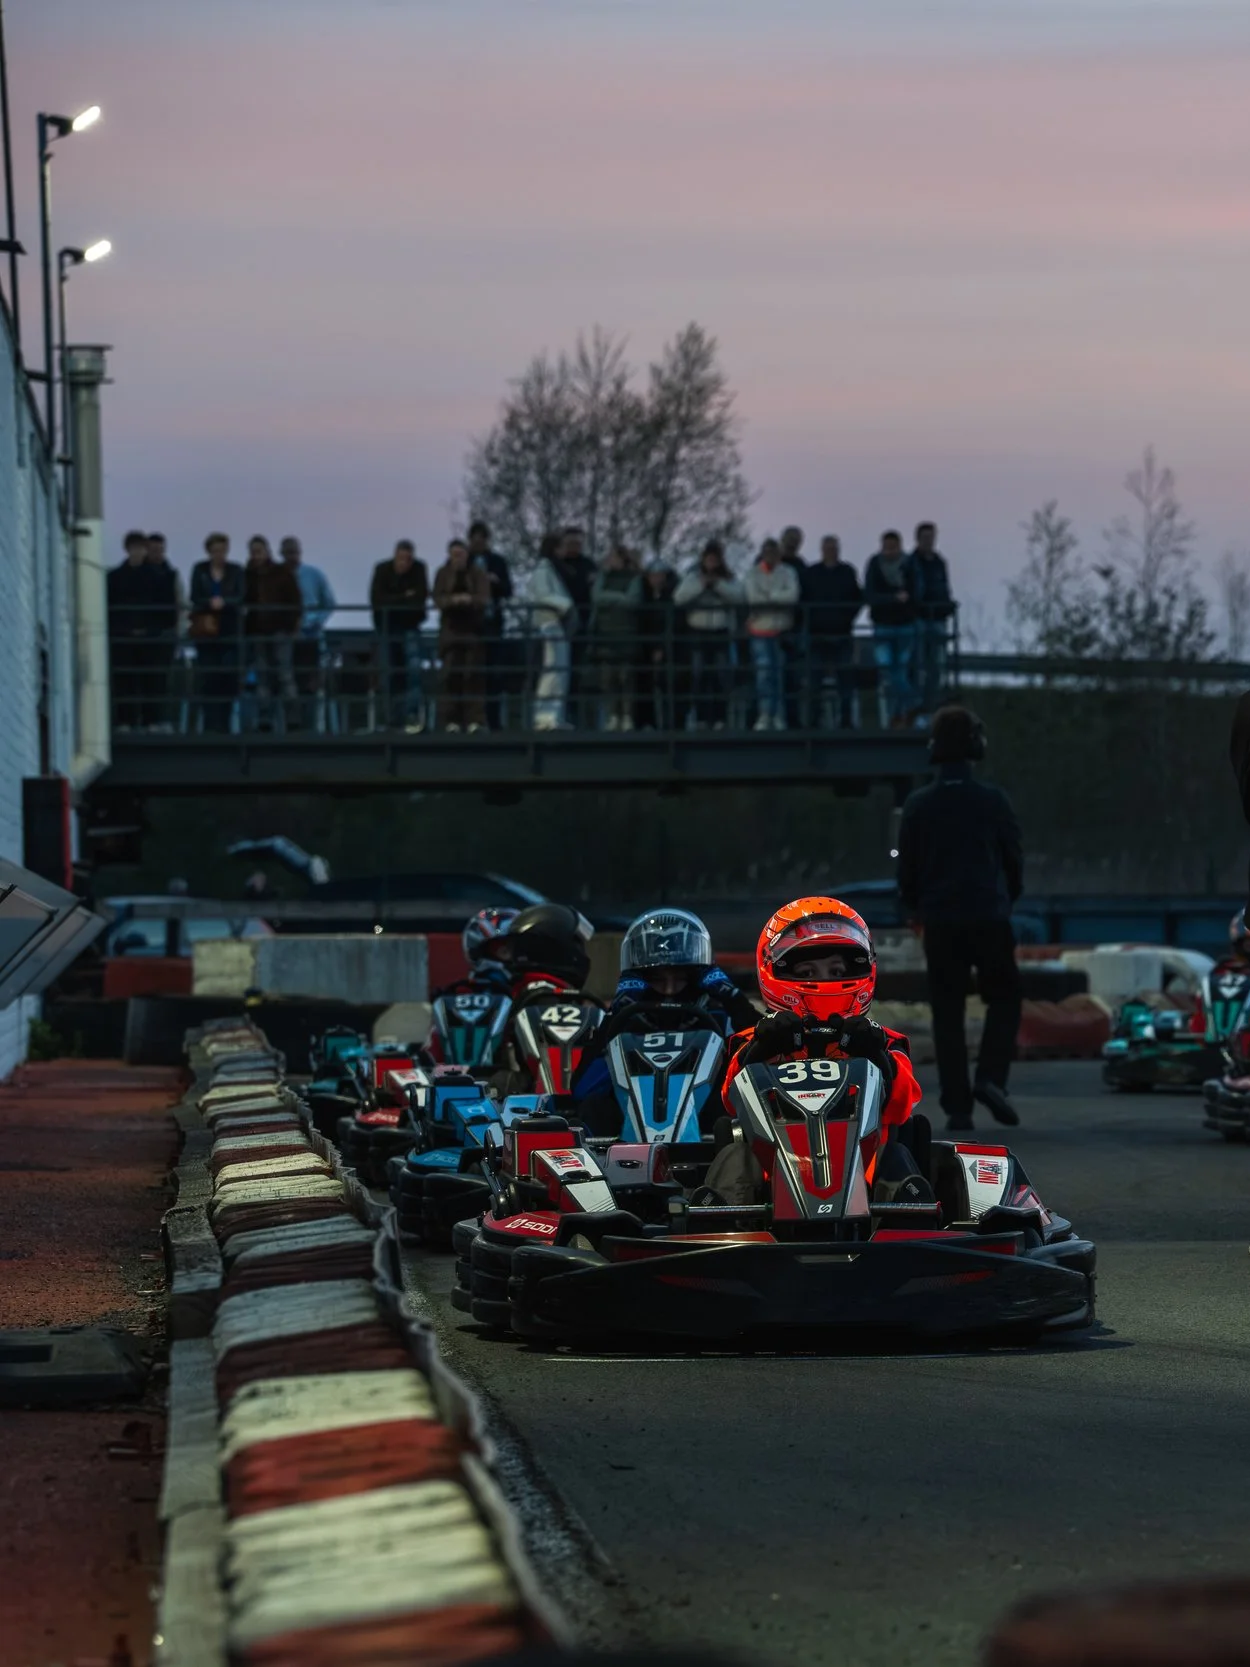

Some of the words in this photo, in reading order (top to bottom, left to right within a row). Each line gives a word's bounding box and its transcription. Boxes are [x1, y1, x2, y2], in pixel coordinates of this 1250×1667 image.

[813, 922, 835, 930] BELL
[455, 994, 490, 1008] 50
[783, 994, 798, 1004] BELL
[540, 1006, 582, 1024] 42
[643, 1032, 684, 1048] 51
[777, 1060, 841, 1084] 39
[520, 1221, 558, 1235] SODI
